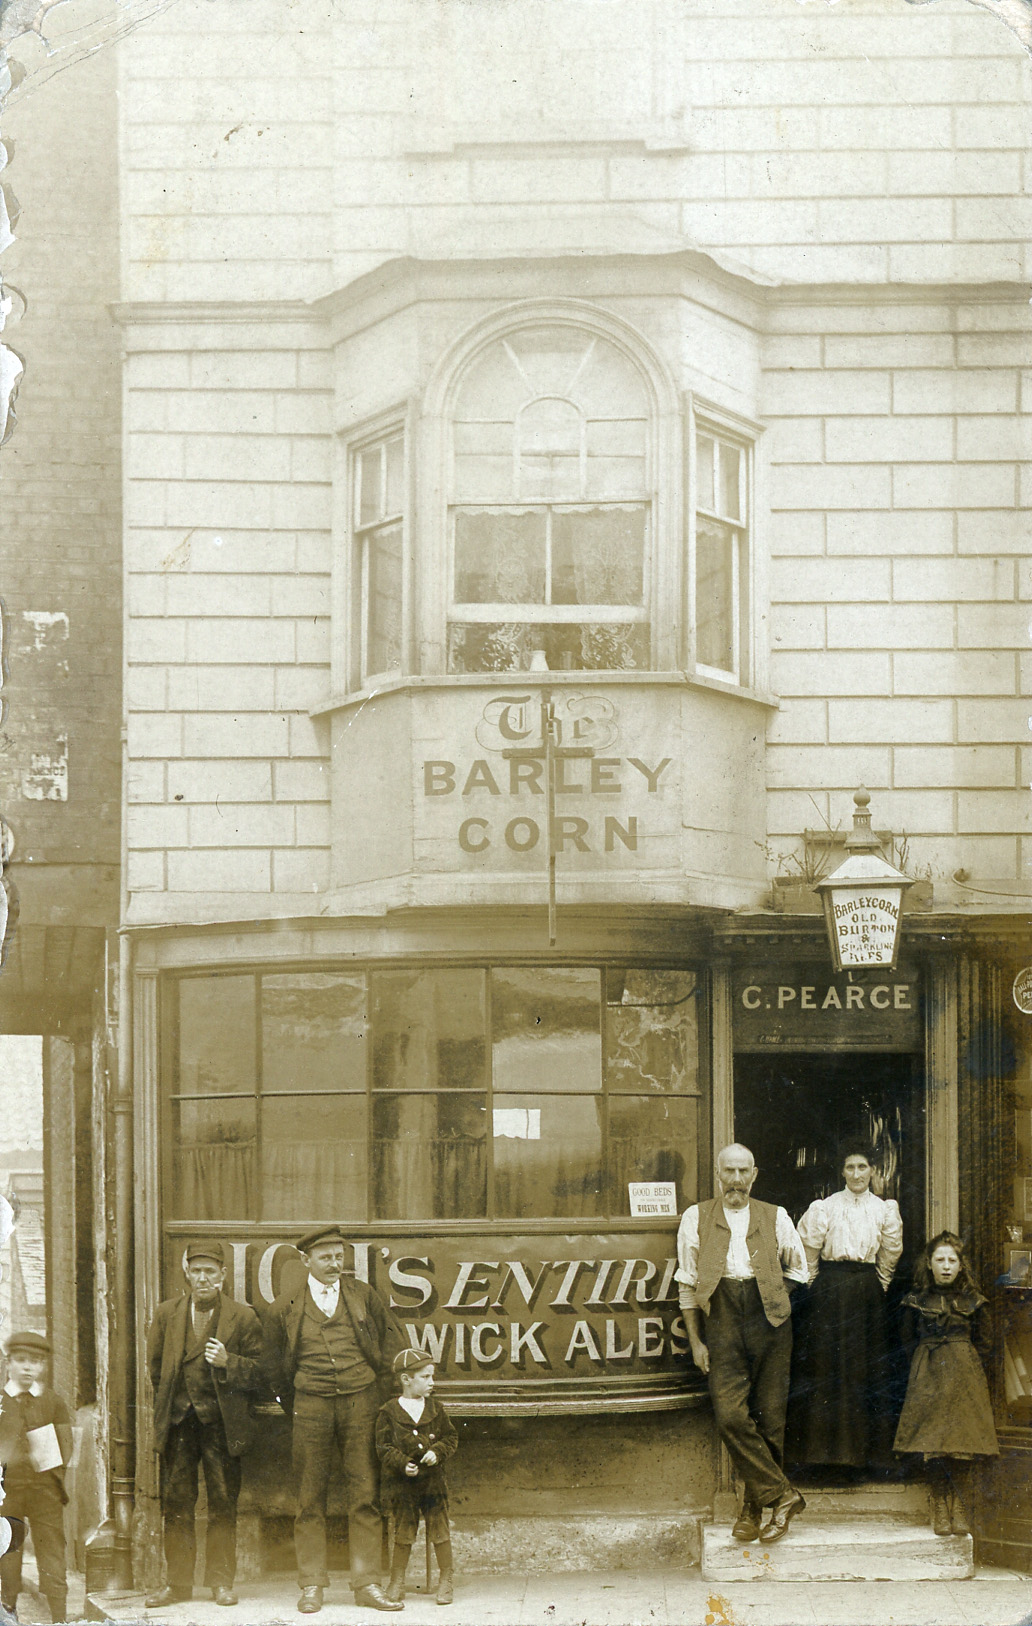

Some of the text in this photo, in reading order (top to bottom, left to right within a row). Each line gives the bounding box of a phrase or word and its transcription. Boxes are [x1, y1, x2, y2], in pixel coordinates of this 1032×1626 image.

[478, 693, 617, 752] The
[424, 757, 672, 796] BARLEY
[458, 816, 637, 852] CORN
[834, 896, 898, 919] BARLEYCORN
[851, 913, 877, 923] OLD
[839, 924, 895, 936] BURTON
[861, 934, 870, 943] &
[632, 1188, 672, 1196] GOOD BEDS
[564, 1317, 690, 1360] ALES
